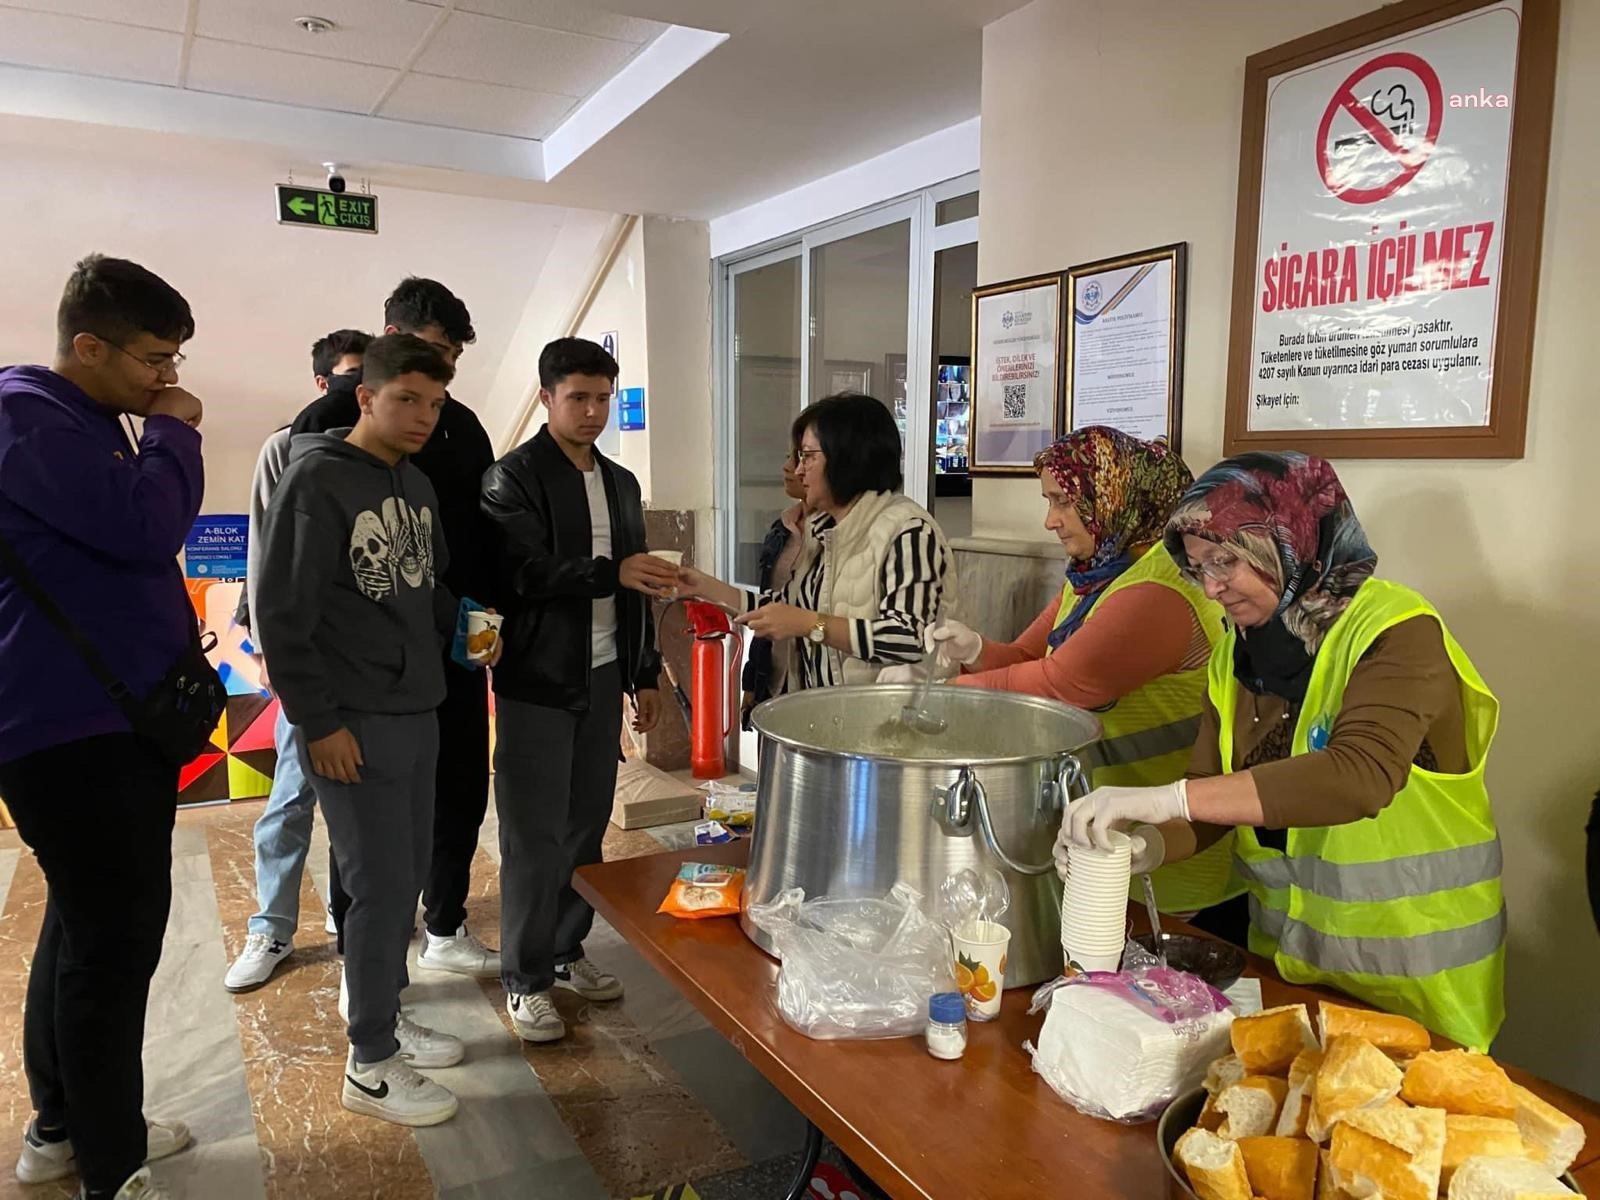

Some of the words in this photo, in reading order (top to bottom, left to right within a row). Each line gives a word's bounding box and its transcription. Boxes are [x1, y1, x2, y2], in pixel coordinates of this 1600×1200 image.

[339, 200, 370, 214] EXIT
[1262, 242, 1358, 313] SİGARA
[1367, 220, 1494, 303] İÇİLMEZ
[1279, 333, 1305, 347] Burada
[1413, 319, 1453, 338] yasaktır.
[1260, 350, 1302, 364] Tüketenlere
[1304, 350, 1313, 360] ve
[1315, 344, 1368, 359] tüketilmesine
[1370, 341, 1386, 359] göz
[1388, 342, 1417, 357] yuman
[1420, 335, 1478, 352] sorumlulara
[1259, 367, 1275, 379] 4207
[1277, 365, 1296, 381] sayılı
[1297, 364, 1320, 377] Kanun
[1323, 363, 1358, 378] uyarınca
[1360, 358, 1379, 373] idari
[1381, 361, 1400, 375] para
[1402, 358, 1430, 371] cezası
[1432, 353, 1481, 372] uygulanır.
[1256, 393, 1282, 409] Şikayet
[1283, 392, 1300, 408] için:
[197, 535, 226, 543] ZEMİN
